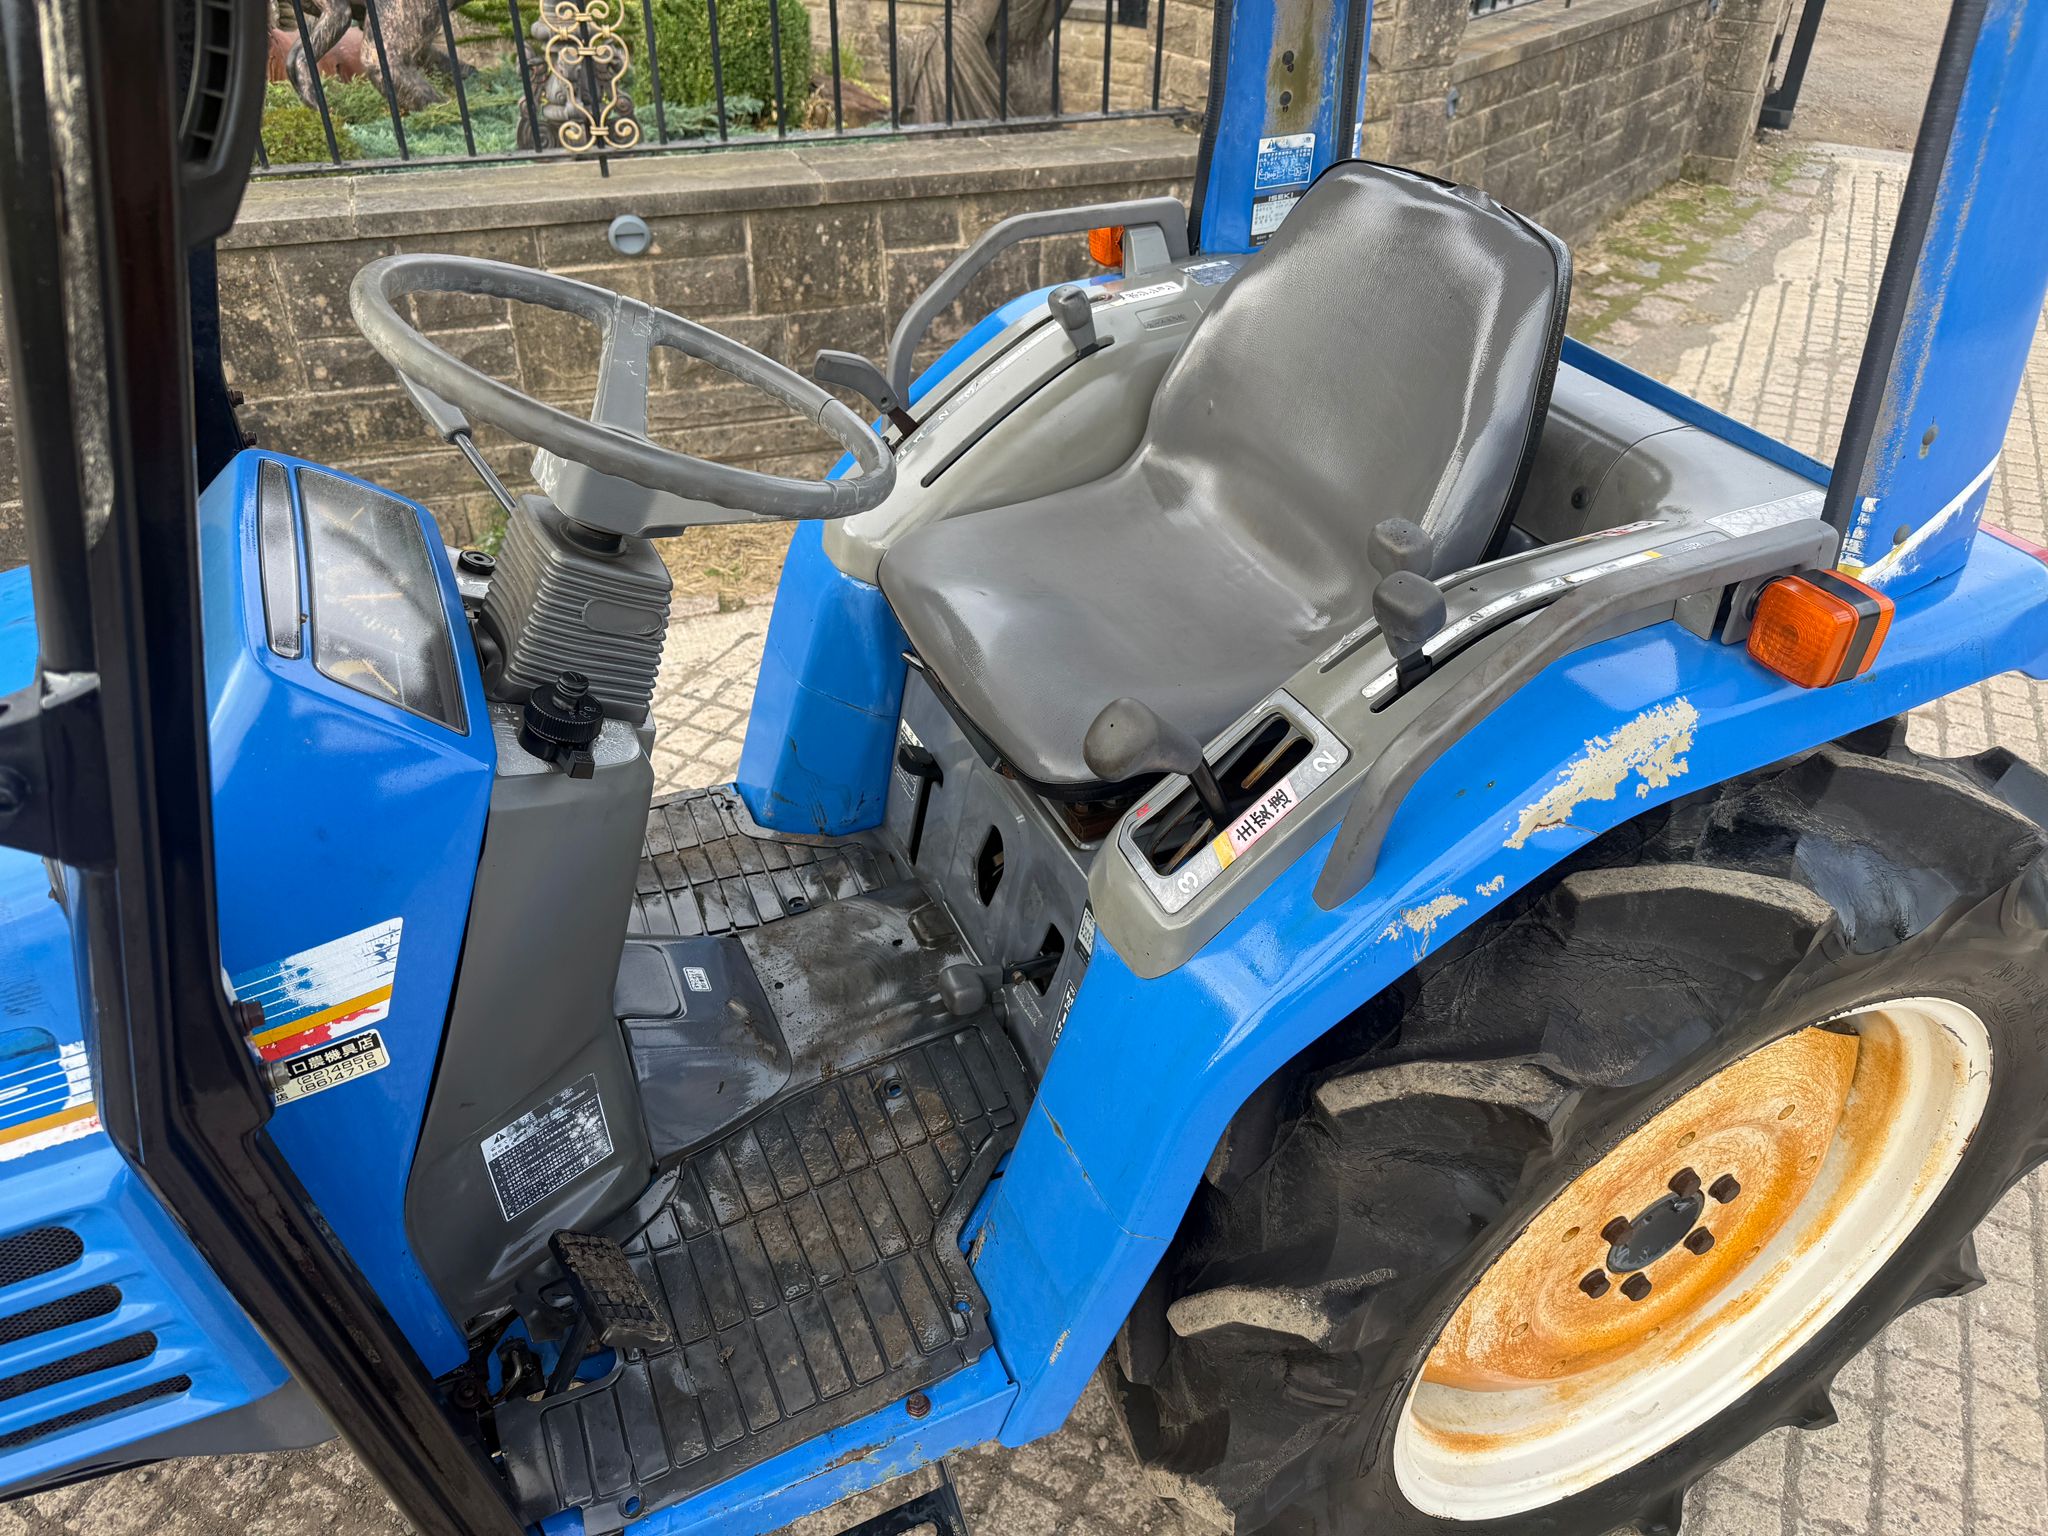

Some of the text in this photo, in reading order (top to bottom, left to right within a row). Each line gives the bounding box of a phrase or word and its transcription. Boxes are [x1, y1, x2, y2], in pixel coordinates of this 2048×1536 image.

[1268, 192, 1294, 202] ISEKI
[938, 409, 950, 421] 2
[1467, 611, 1485, 622] 2
[1312, 750, 1338, 773] 2
[1236, 787, 1293, 843] 主変速
[1177, 871, 1199, 894] 3
[289, 1037, 375, 1076] 口農機具店
[296, 1050, 375, 1086] (22)4856
[300, 1058, 378, 1093] (86)4718
